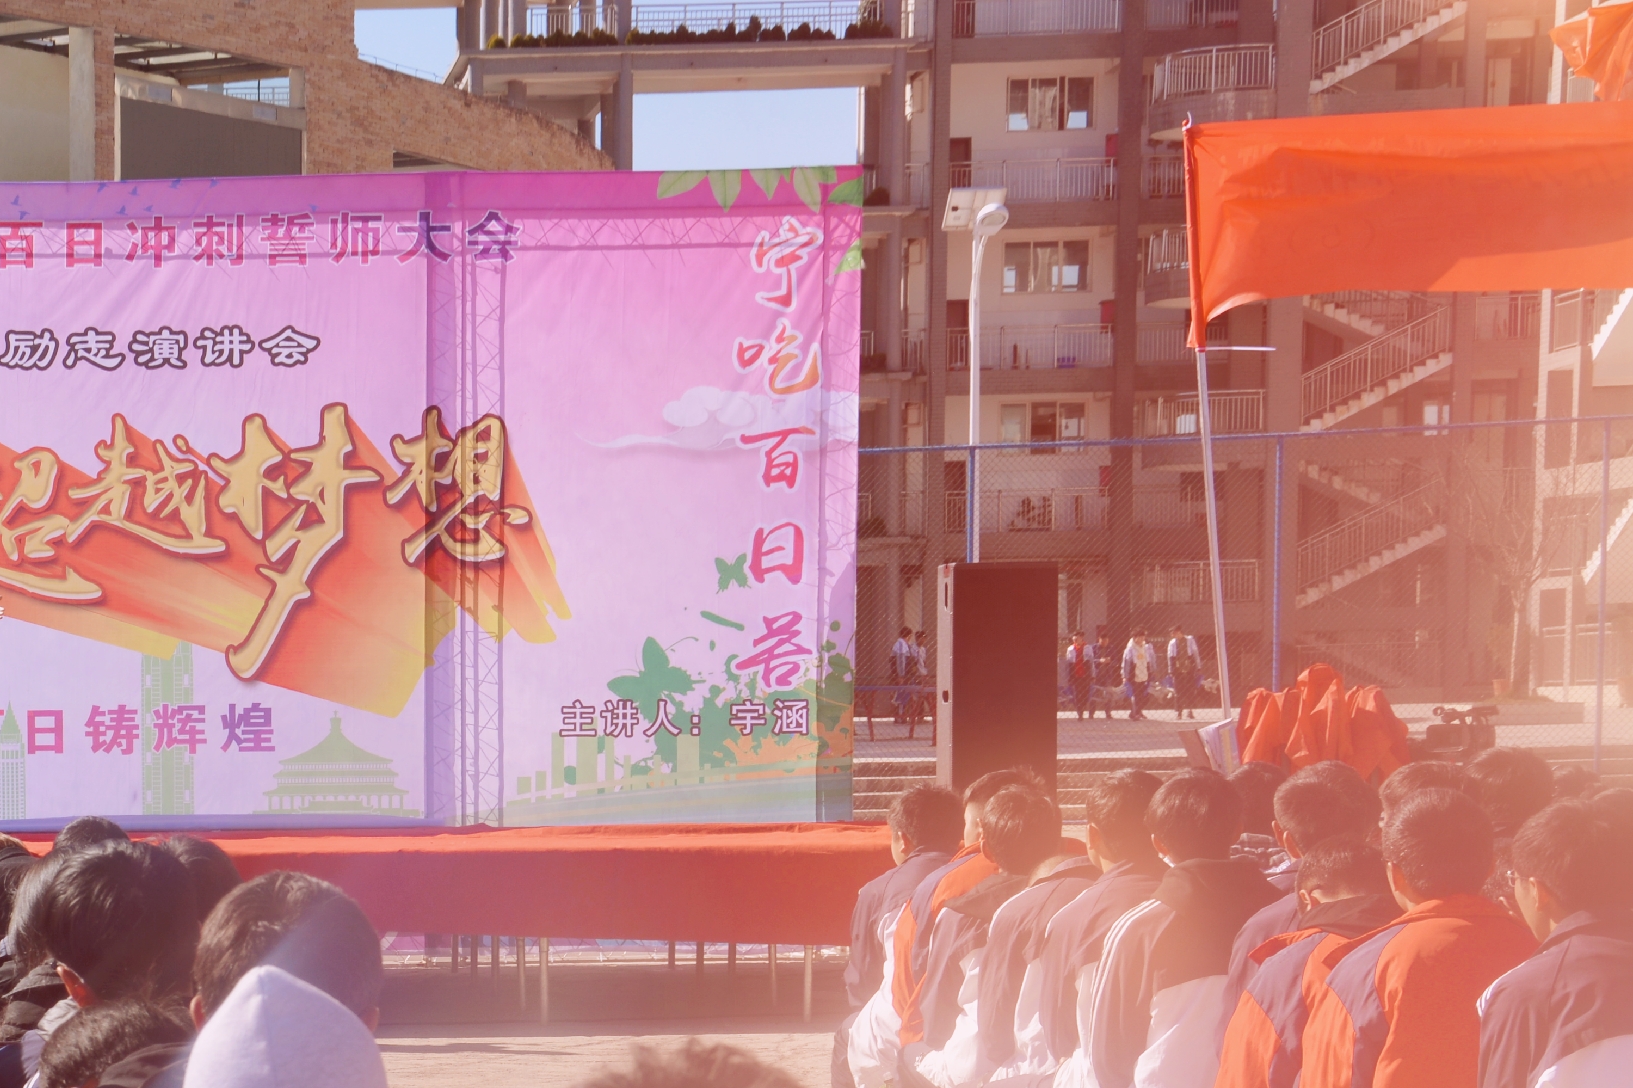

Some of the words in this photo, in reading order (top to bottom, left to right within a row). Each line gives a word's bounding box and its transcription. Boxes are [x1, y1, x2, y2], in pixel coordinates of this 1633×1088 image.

[732, 217, 821, 689] 宁吃百日苦
